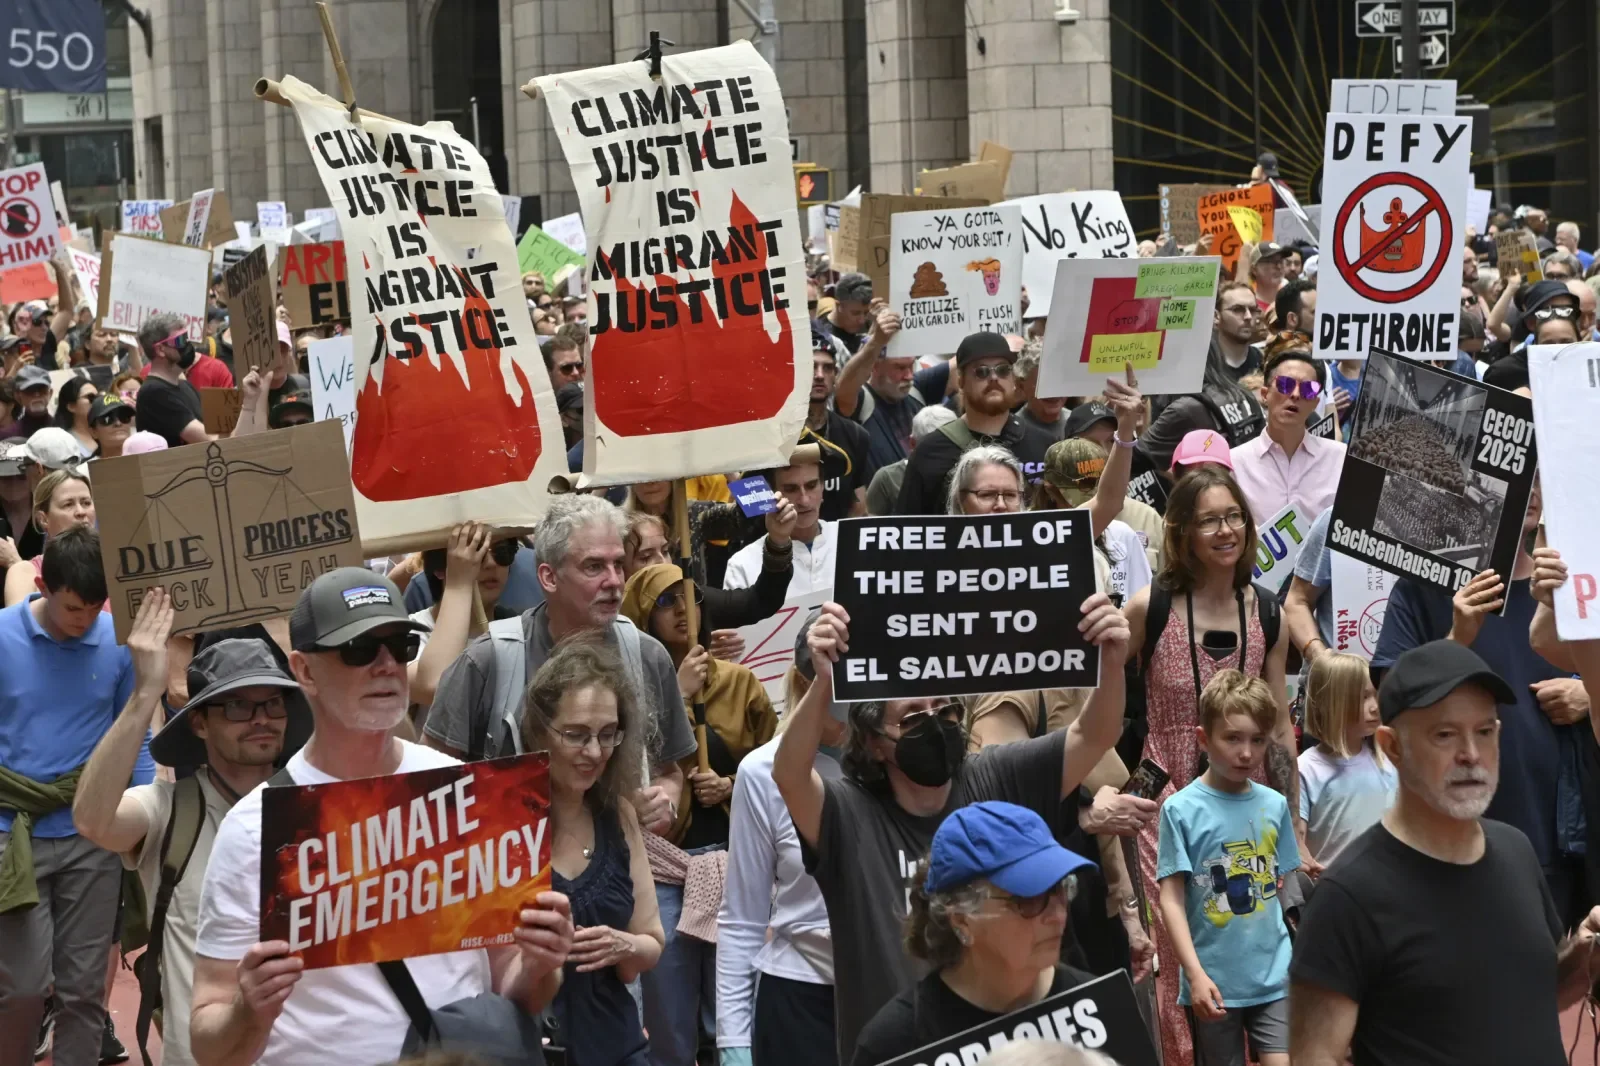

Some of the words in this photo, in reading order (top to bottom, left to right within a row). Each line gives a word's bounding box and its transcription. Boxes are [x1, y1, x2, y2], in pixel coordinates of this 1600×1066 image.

[1372, 11, 1399, 25] ONE
[9, 29, 94, 72] 550
[571, 76, 760, 137] CLIMATE
[592, 122, 767, 187] JUSTICE
[1332, 121, 1468, 164] DEFY
[656, 188, 695, 227] IS
[1200, 189, 1251, 209] IGNORE
[131, 215, 161, 231] FIRS
[964, 211, 1003, 229] GOTTA
[1021, 203, 1066, 253] No
[1071, 201, 1131, 250] King
[0, 234, 55, 266] HIM!
[387, 222, 427, 259] IS
[591, 219, 783, 282] MIGRANT
[901, 235, 943, 253] KNOW
[948, 232, 981, 250] YOUR
[74, 254, 101, 280] STO
[1140, 267, 1166, 278] BRING
[1170, 265, 1206, 276] KILMAR
[589, 266, 790, 335] JUSTICE
[1183, 280, 1214, 292] GARCIA
[903, 297, 960, 317] FERTILIZE
[925, 312, 965, 327] GARDEN
[978, 304, 1013, 320] FLUSH
[1114, 315, 1140, 327] STOP
[1162, 302, 1189, 313] HOME
[1165, 311, 1191, 325] NOW!
[1319, 312, 1454, 352] DETHRONE
[1095, 351, 1153, 364] DETENTIONS
[1098, 342, 1146, 354] UNLAWFUL
[1482, 408, 1535, 447] CECOT
[1477, 434, 1527, 475] 2025
[118, 535, 205, 578] DUE
[243, 508, 352, 555] PROCESS
[858, 525, 946, 550] FREE
[957, 522, 1022, 549] ALL
[1032, 520, 1072, 545] OF
[1331, 519, 1451, 587] Sachsenhausen
[1453, 568, 1475, 592] 19
[853, 570, 929, 595] THE
[936, 564, 1070, 593] PEOPLE
[126, 578, 214, 620] FCK
[348, 595, 389, 609] patagonia
[886, 612, 980, 638] SENT
[989, 609, 1038, 634] TO
[1337, 609, 1349, 651] KINGS
[1348, 620, 1358, 637] NO
[846, 657, 888, 682] EL
[899, 648, 1085, 680] SALVADOR
[298, 774, 480, 895] CLIMATE
[289, 816, 548, 953] EMERGENCY
